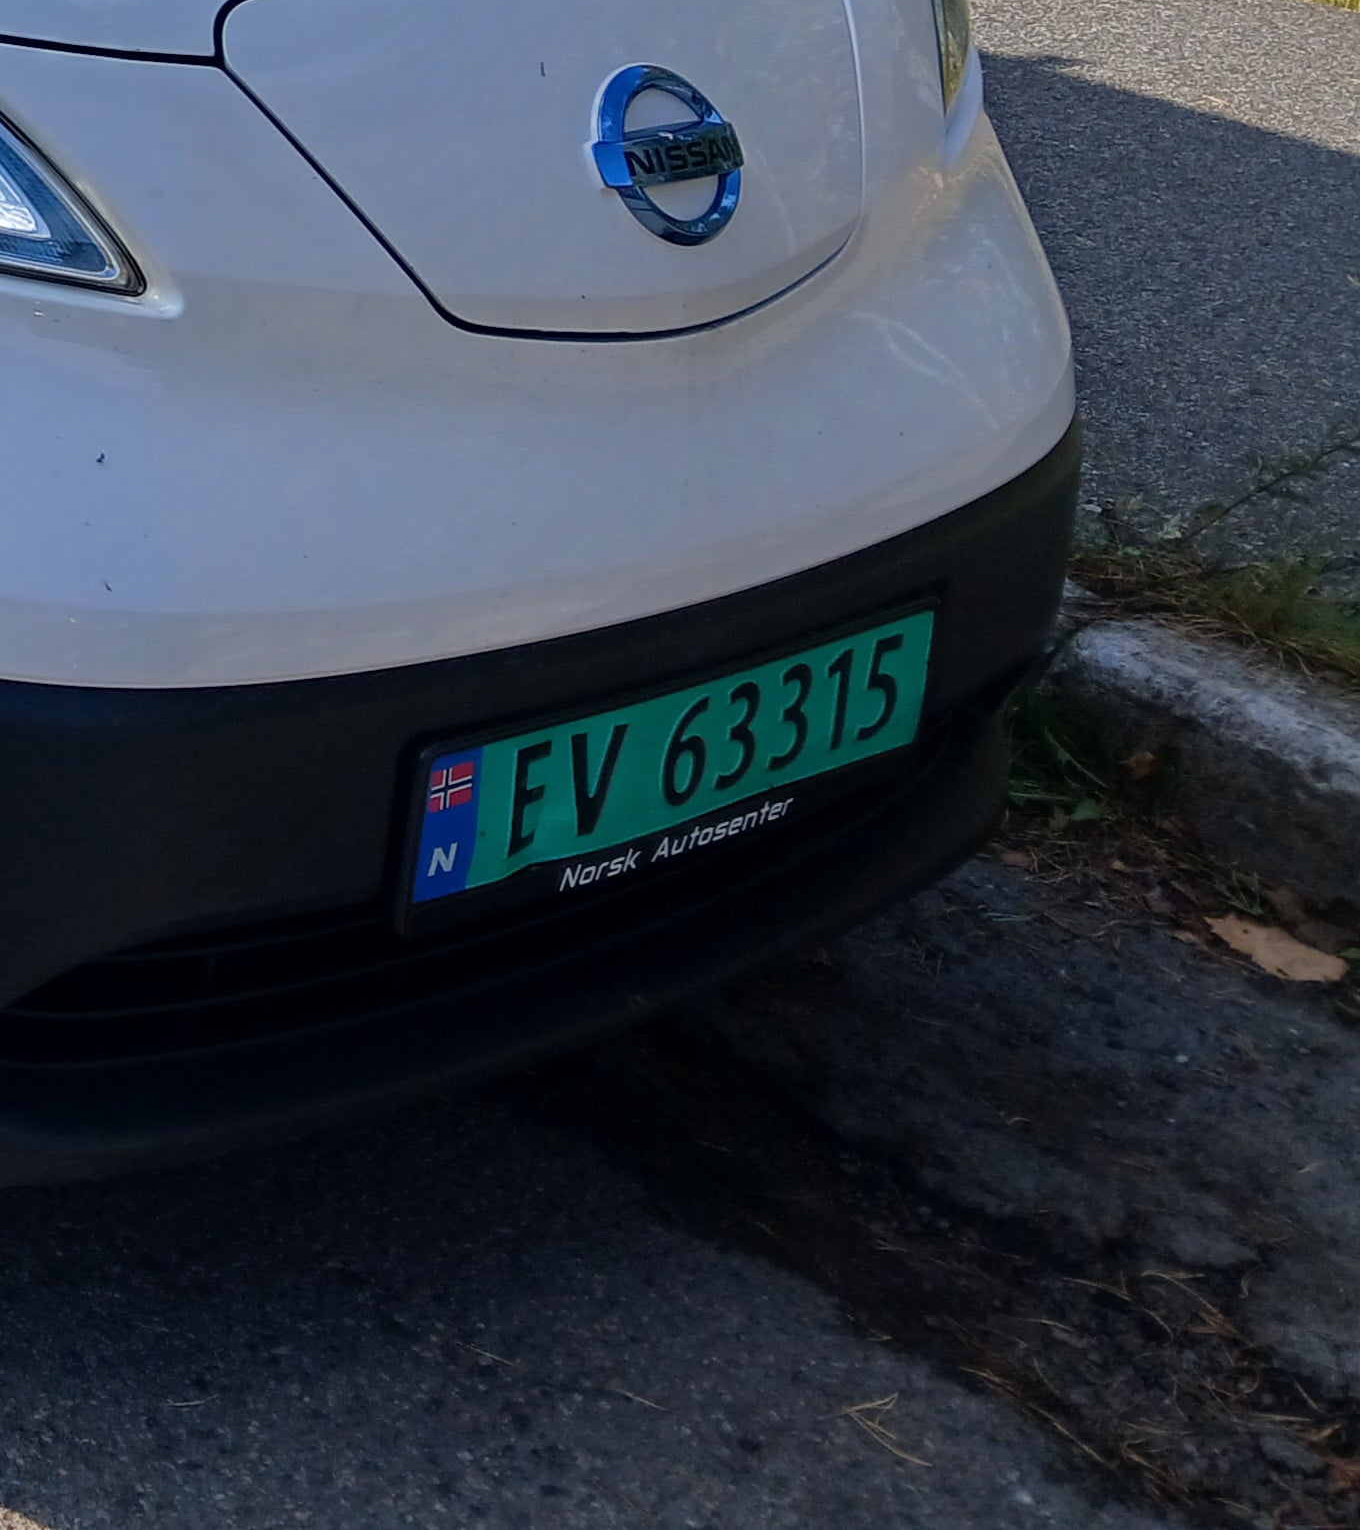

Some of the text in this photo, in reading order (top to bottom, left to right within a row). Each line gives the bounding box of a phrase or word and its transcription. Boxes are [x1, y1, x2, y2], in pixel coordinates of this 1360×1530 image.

[624, 134, 744, 178] NISSAN
[506, 632, 905, 860] EV 63315
[426, 841, 459, 878] N
[558, 794, 795, 893] Norsk Autosenter
